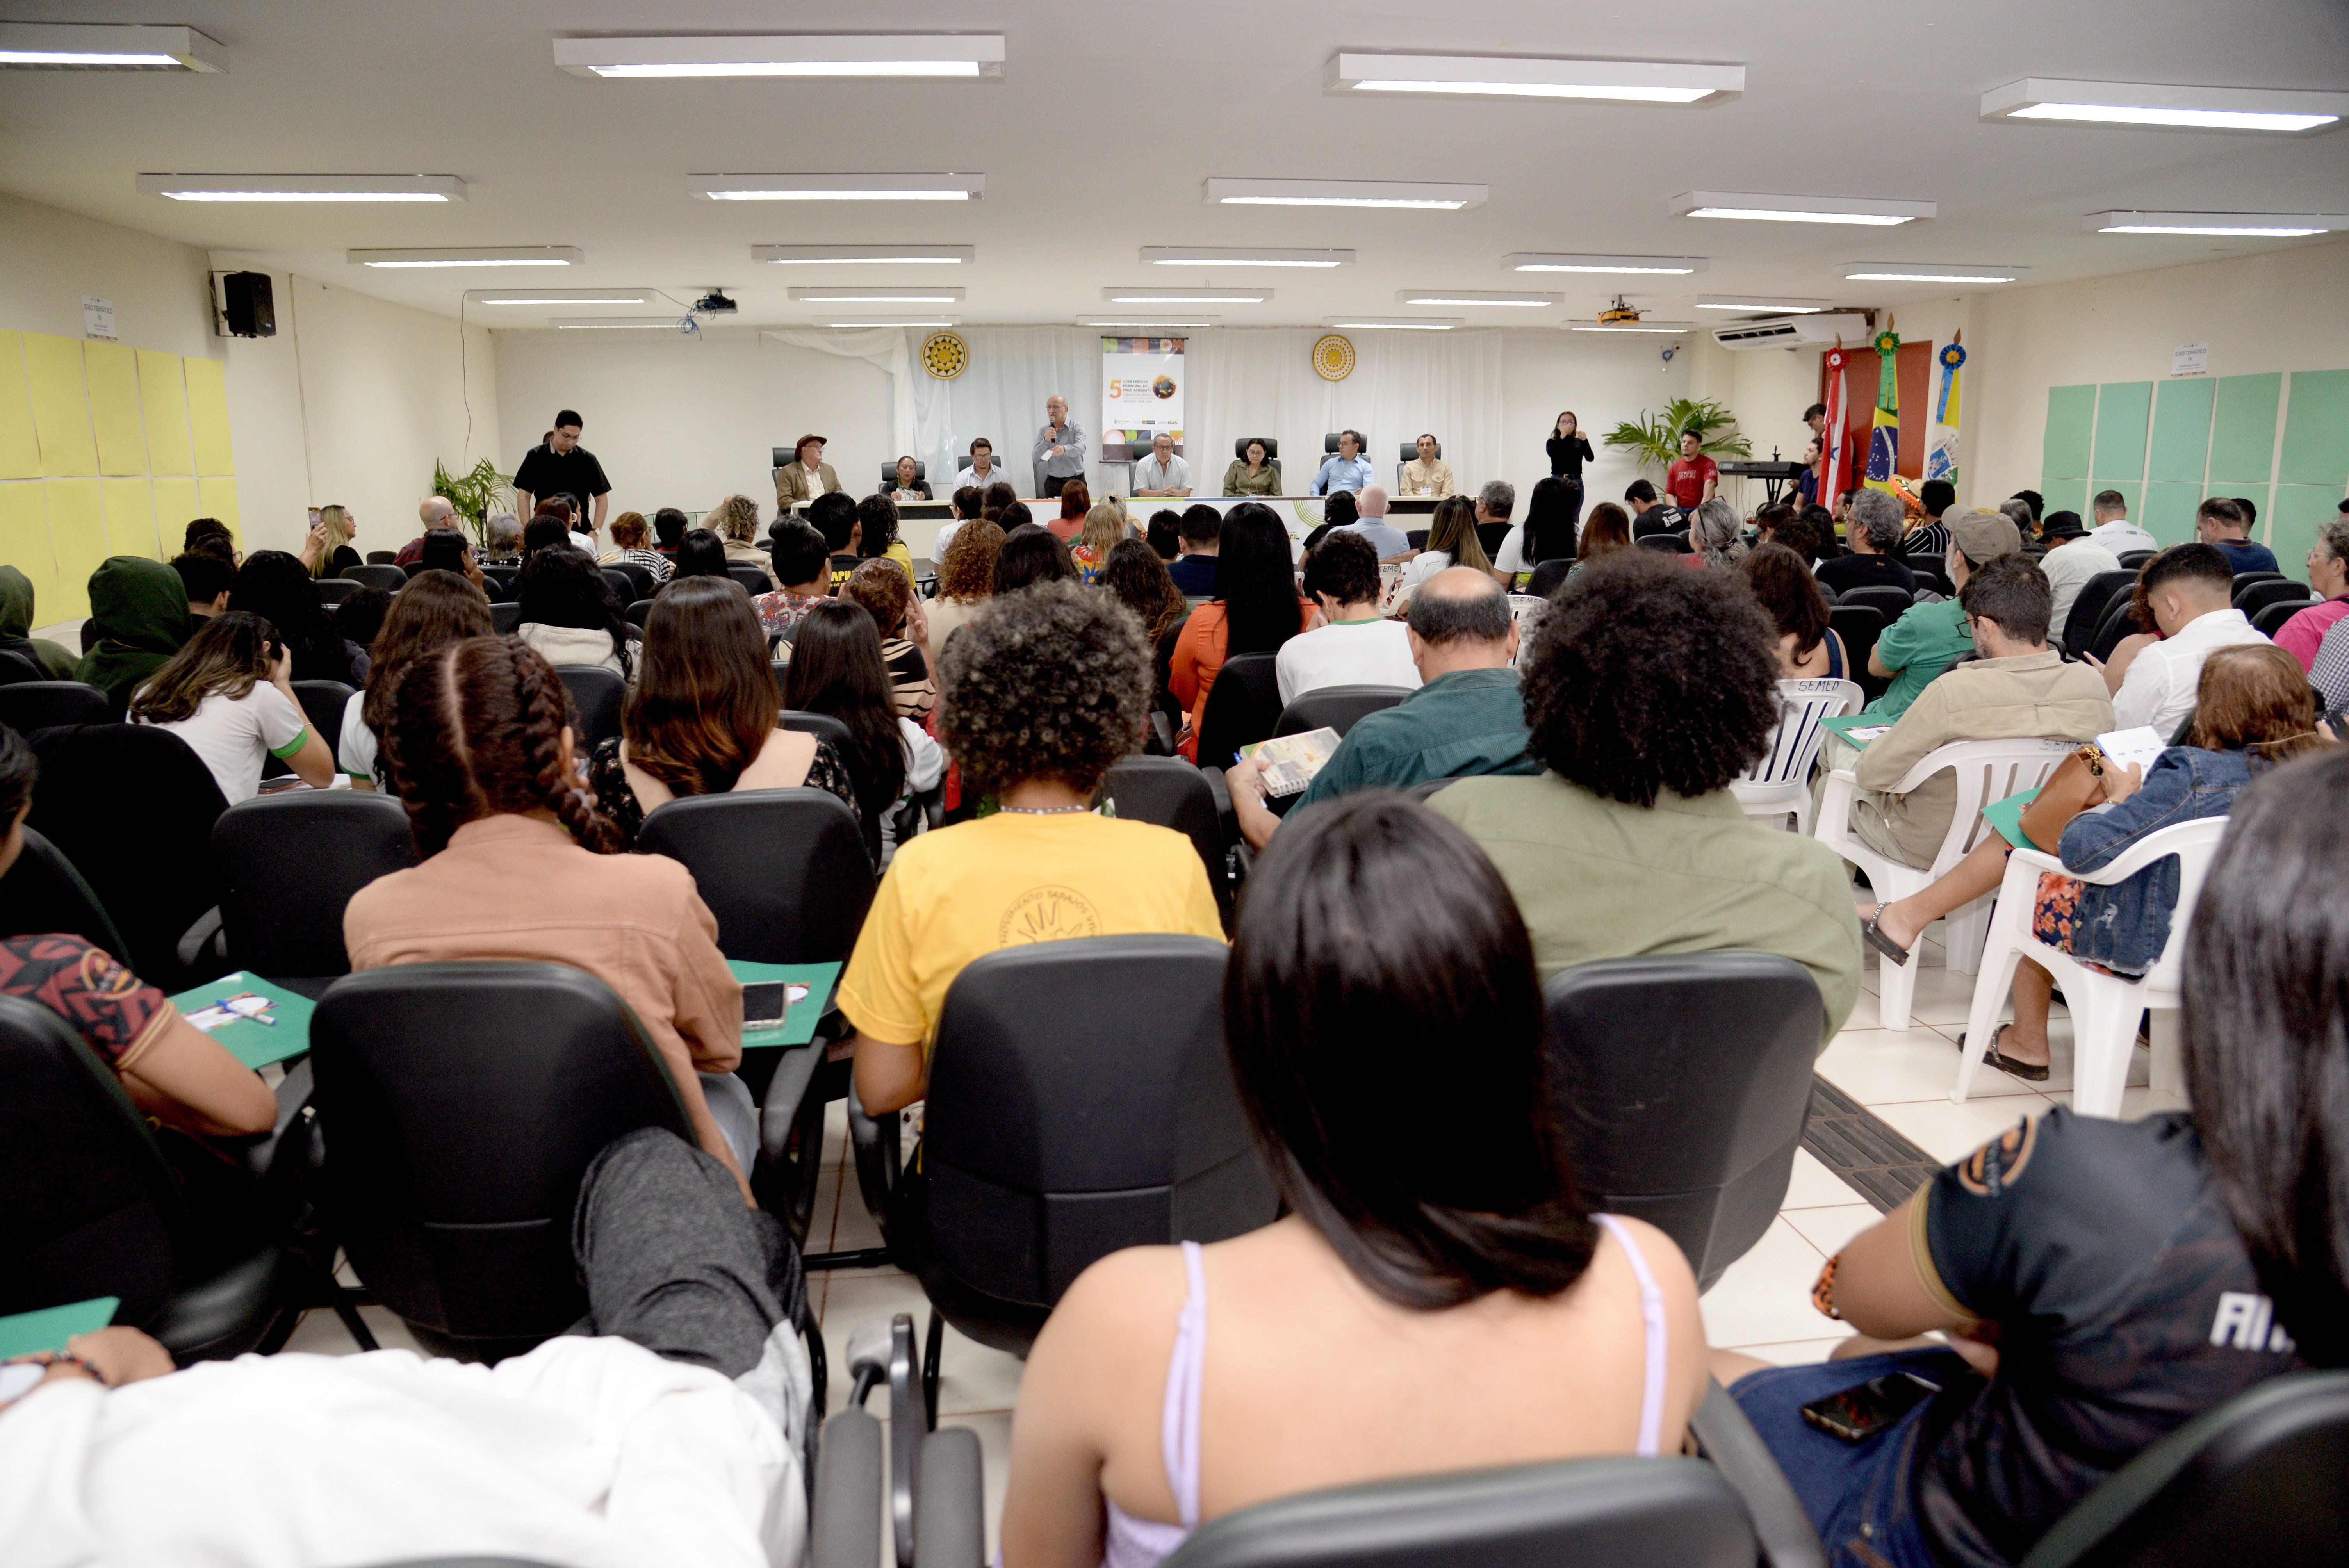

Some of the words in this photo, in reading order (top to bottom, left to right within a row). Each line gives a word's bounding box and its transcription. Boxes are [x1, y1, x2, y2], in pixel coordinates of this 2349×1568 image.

[1798, 681, 1840, 692] SEMED
[2039, 739, 2085, 752] SEME
[1086, 915, 1097, 936] VIV
